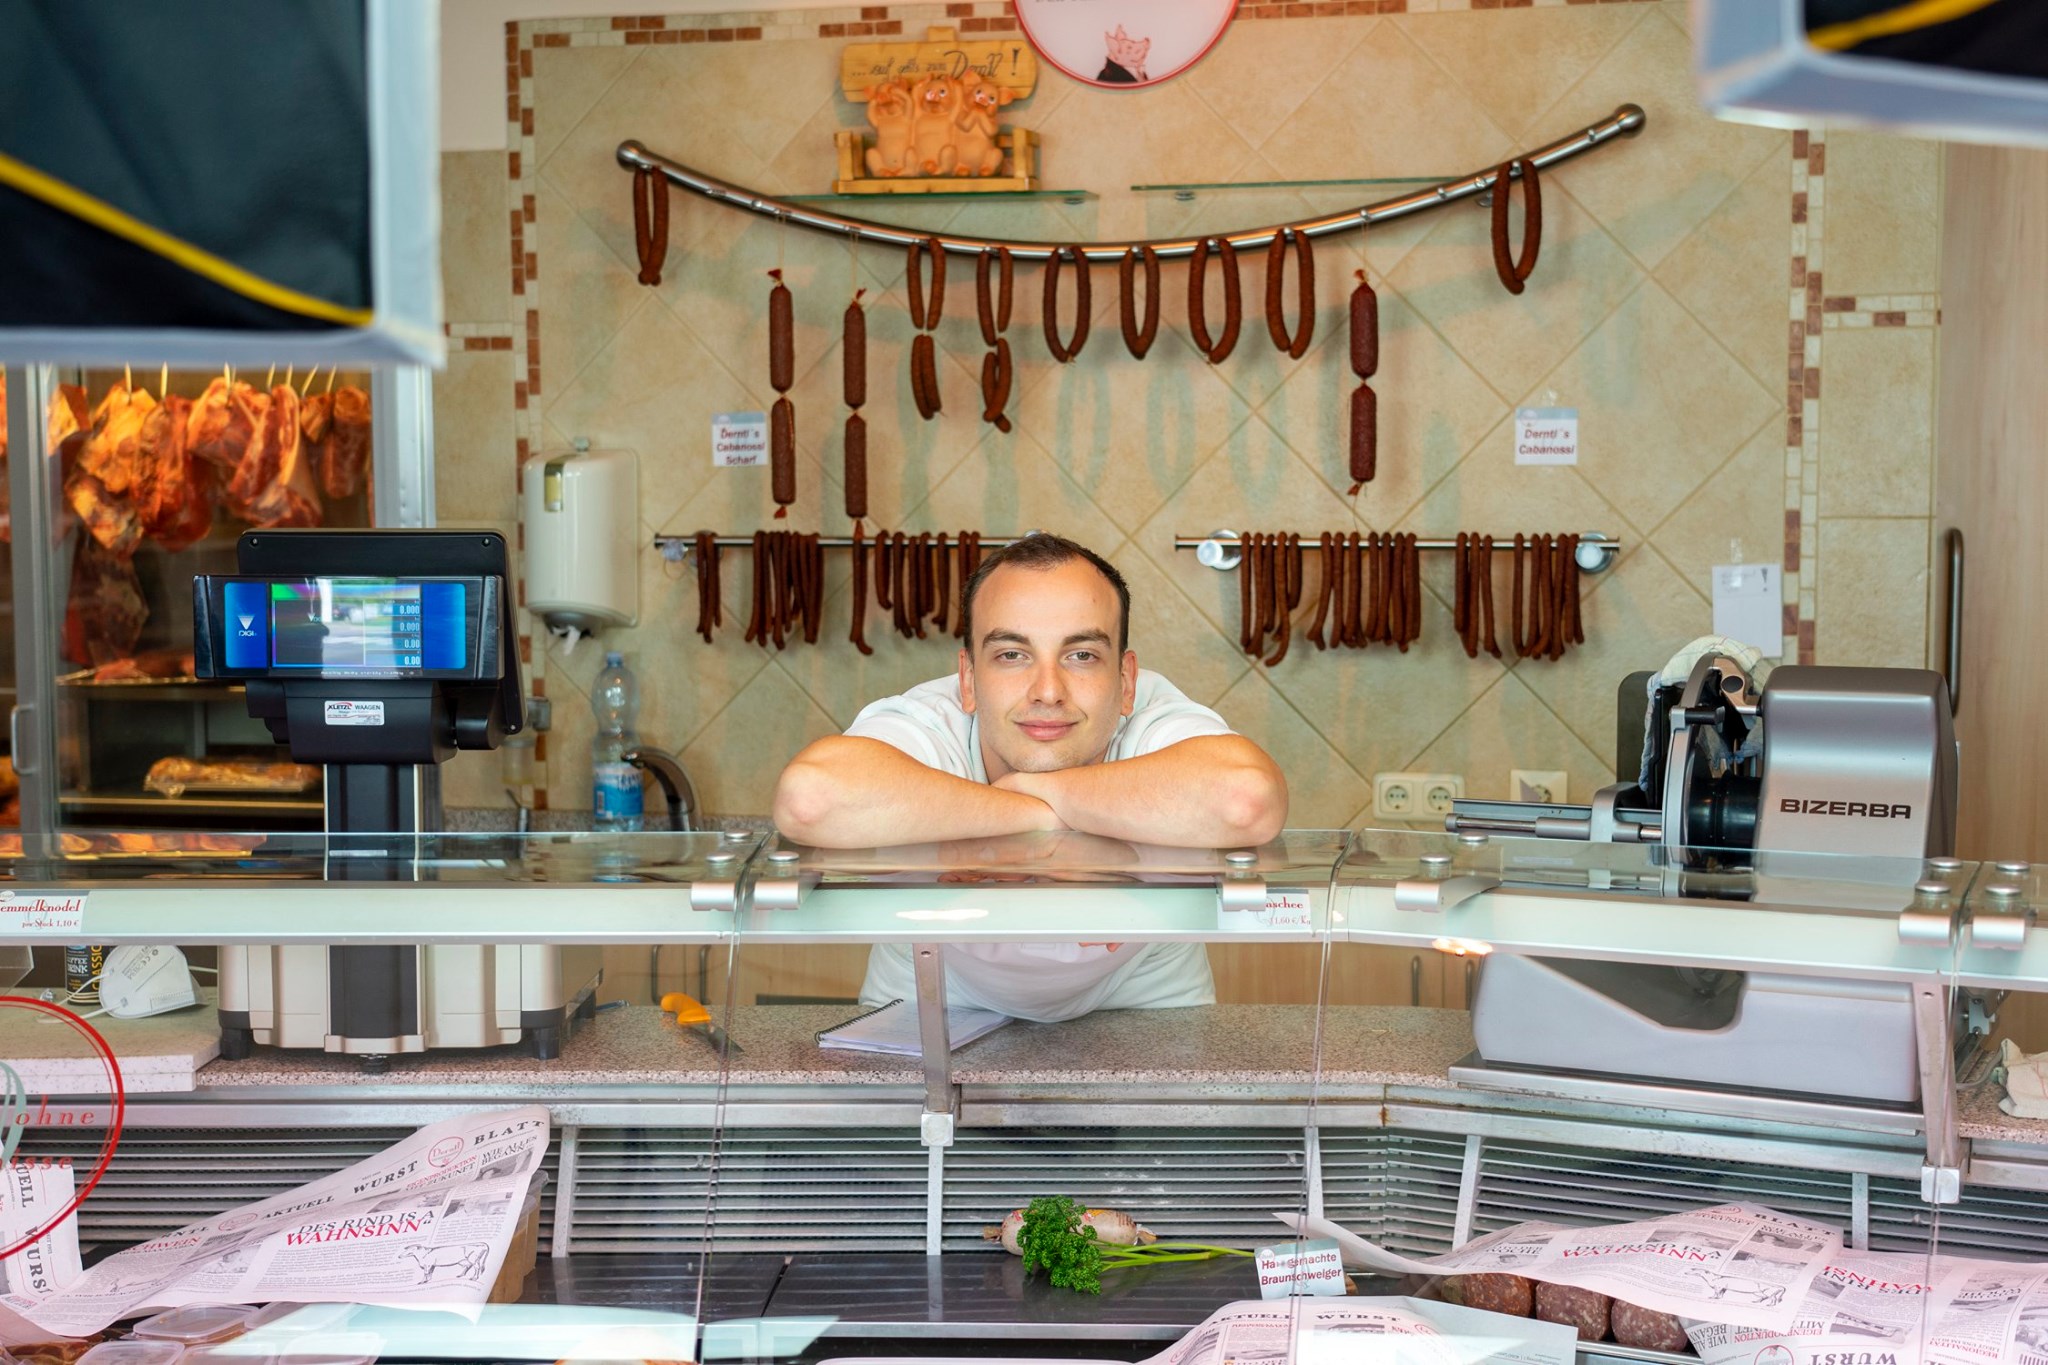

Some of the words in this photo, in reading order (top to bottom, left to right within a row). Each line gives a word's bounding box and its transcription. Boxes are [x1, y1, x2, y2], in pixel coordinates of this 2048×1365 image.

[717, 442, 766, 452] Cabanossi
[1519, 445, 1575, 455] Cabanossi
[238, 629, 255, 637] DIGI
[1780, 798, 1912, 819] BIZERBA
[1265, 896, 1304, 909] aschee
[90, 944, 103, 991] CASSIC
[15, 1094, 95, 1126] ohne
[0, 1146, 74, 1171] isse
[353, 1160, 419, 1194] WURST
[473, 1120, 546, 1146] BLATT
[16, 1163, 34, 1208] UELL
[261, 1195, 336, 1219] AKTUELL
[342, 1215, 394, 1230] RIND
[399, 1211, 418, 1222] IS
[422, 1209, 435, 1219] A
[1754, 1213, 1836, 1236] BLATT
[1261, 1253, 1337, 1270] Hagemachte
[1261, 1268, 1342, 1286] Braunschweiger
[1824, 1265, 1933, 1293] WAHNSI
[1315, 1313, 1402, 1322] WURST
